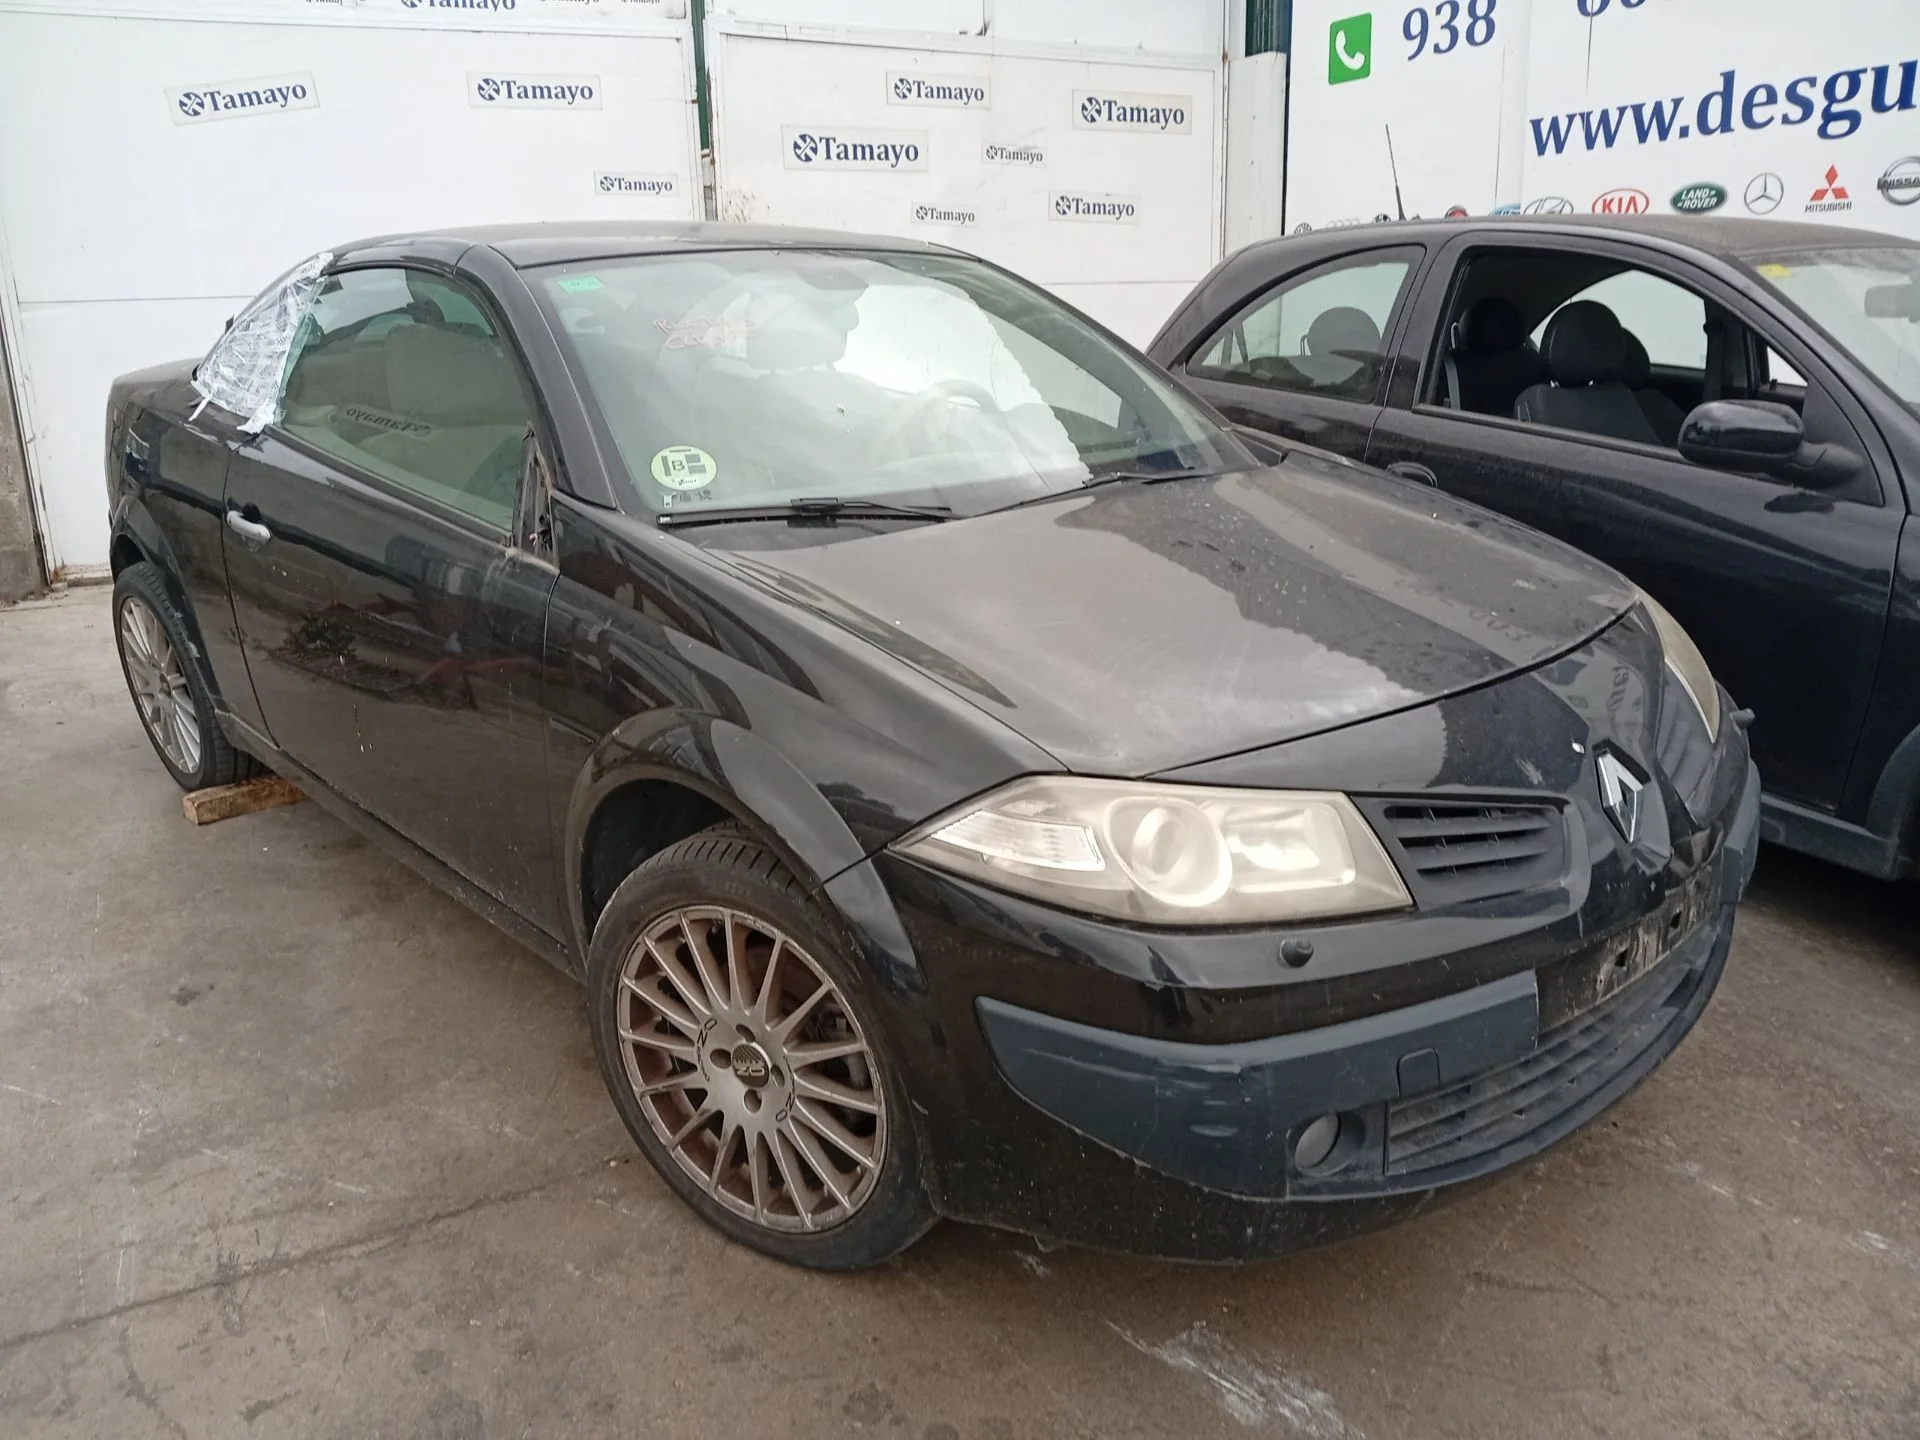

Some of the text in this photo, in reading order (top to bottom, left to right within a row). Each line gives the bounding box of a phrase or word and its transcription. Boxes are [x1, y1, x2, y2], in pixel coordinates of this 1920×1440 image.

[1403, 0, 1497, 61] 938
[204, 84, 307, 111] Tamayo
[501, 80, 594, 105] Tamayo
[913, 80, 985, 105] Tamayo
[1102, 100, 1185, 130] Tamayo
[1530, 59, 1920, 156] www.desgu
[819, 136, 919, 167] Tamayo
[998, 147, 1043, 164] Tamayo
[614, 177, 673, 195] Tamayo
[1681, 187, 1710, 199] LAND
[1071, 198, 1135, 220] Tamayo
[1602, 196, 1639, 213] KIA
[1682, 196, 1718, 209] ROVER
[1805, 201, 1853, 214] MITSUBISHI
[928, 207, 975, 224] Tamayo
